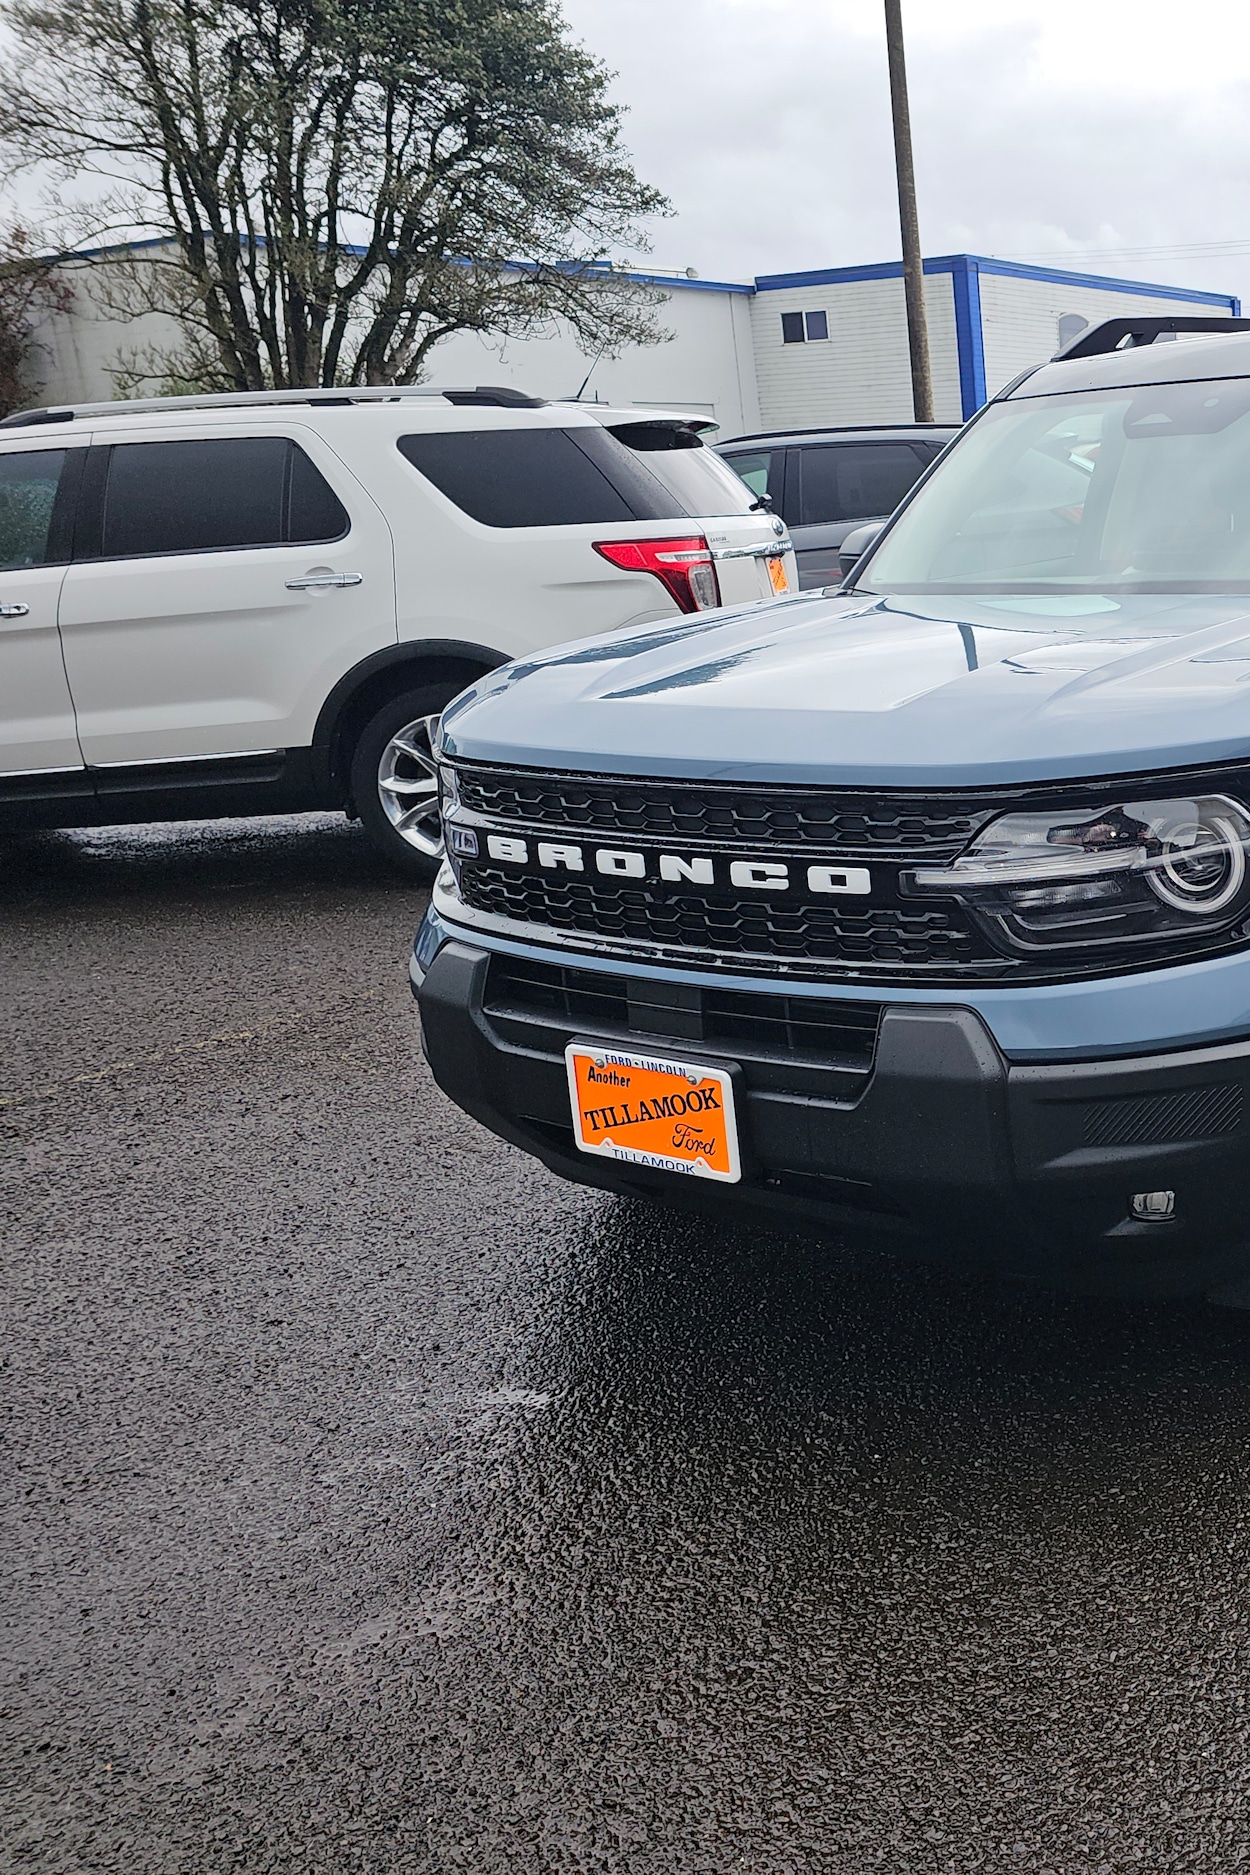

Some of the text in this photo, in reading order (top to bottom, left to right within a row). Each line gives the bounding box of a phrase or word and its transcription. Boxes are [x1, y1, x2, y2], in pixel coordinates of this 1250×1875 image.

[487, 834, 871, 895] BRONCO
[587, 1065, 630, 1088] Another
[604, 1054, 686, 1077] FORD LINCOLN
[584, 1087, 721, 1131] TILLAMOOK
[672, 1123, 716, 1156] Ford
[612, 1148, 696, 1175] TILLAMOOK
